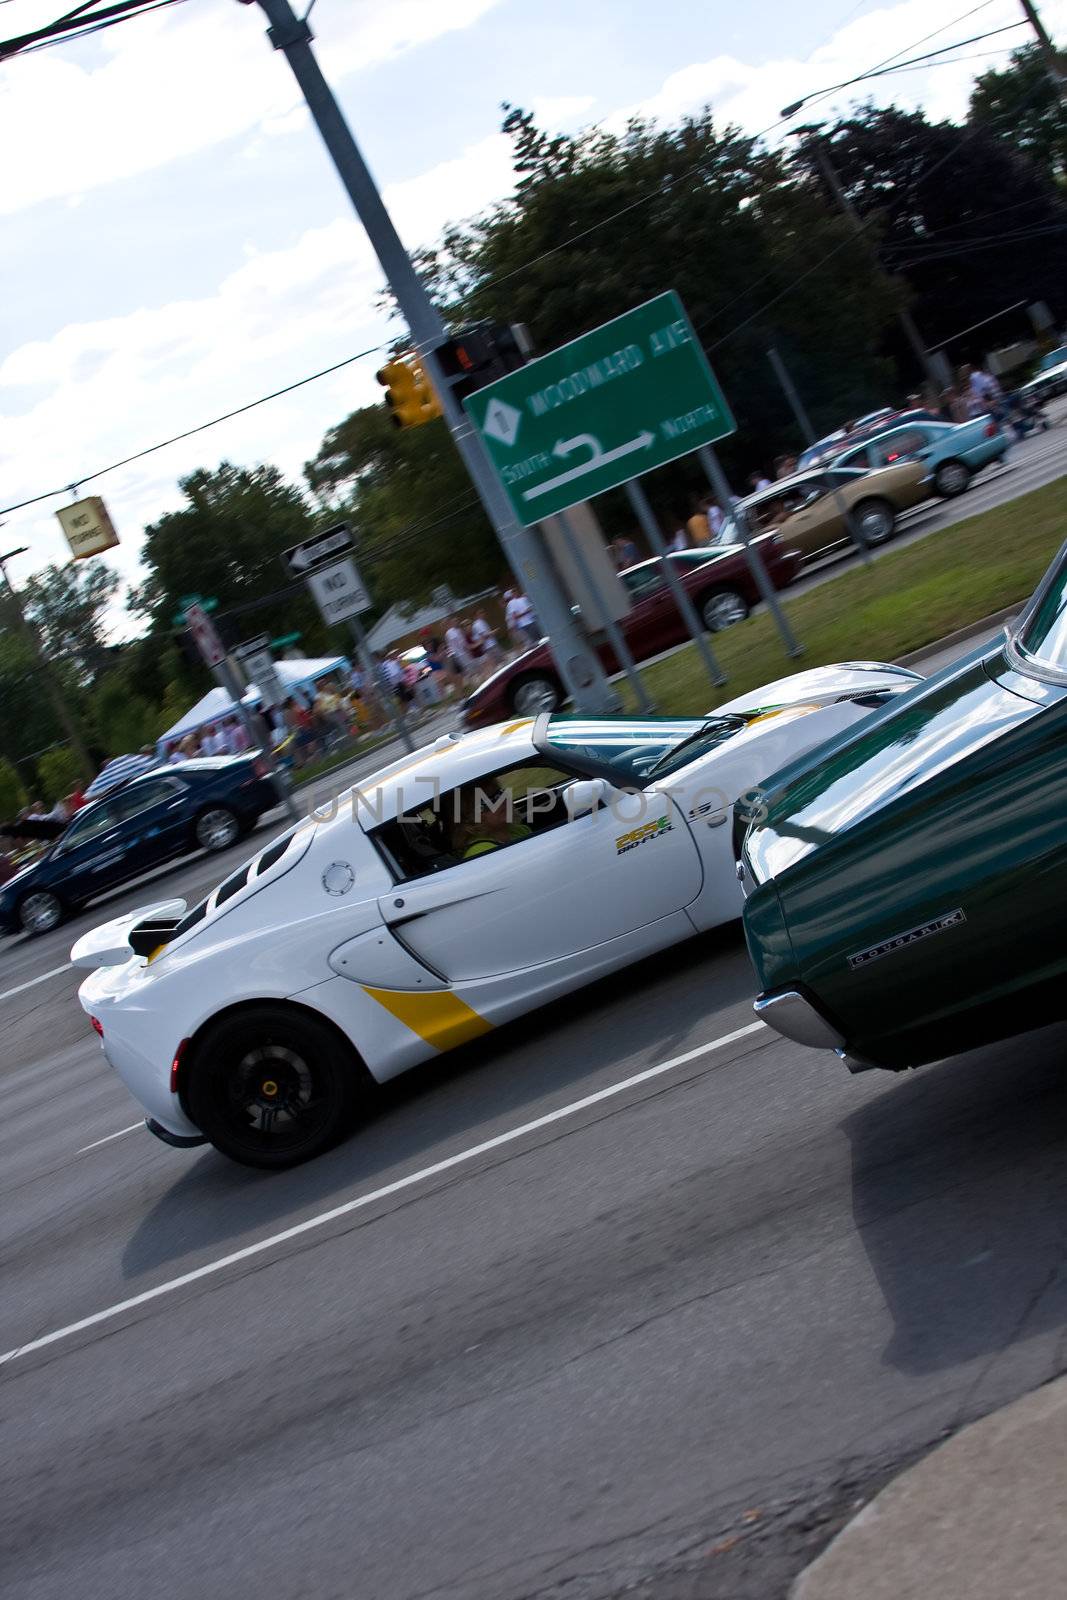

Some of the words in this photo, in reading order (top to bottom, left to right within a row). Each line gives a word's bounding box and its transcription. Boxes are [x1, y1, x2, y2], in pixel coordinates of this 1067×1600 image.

[527, 343, 644, 417] WOODWARD
[649, 318, 692, 358] AVE
[854, 926, 934, 964] COUGAR
